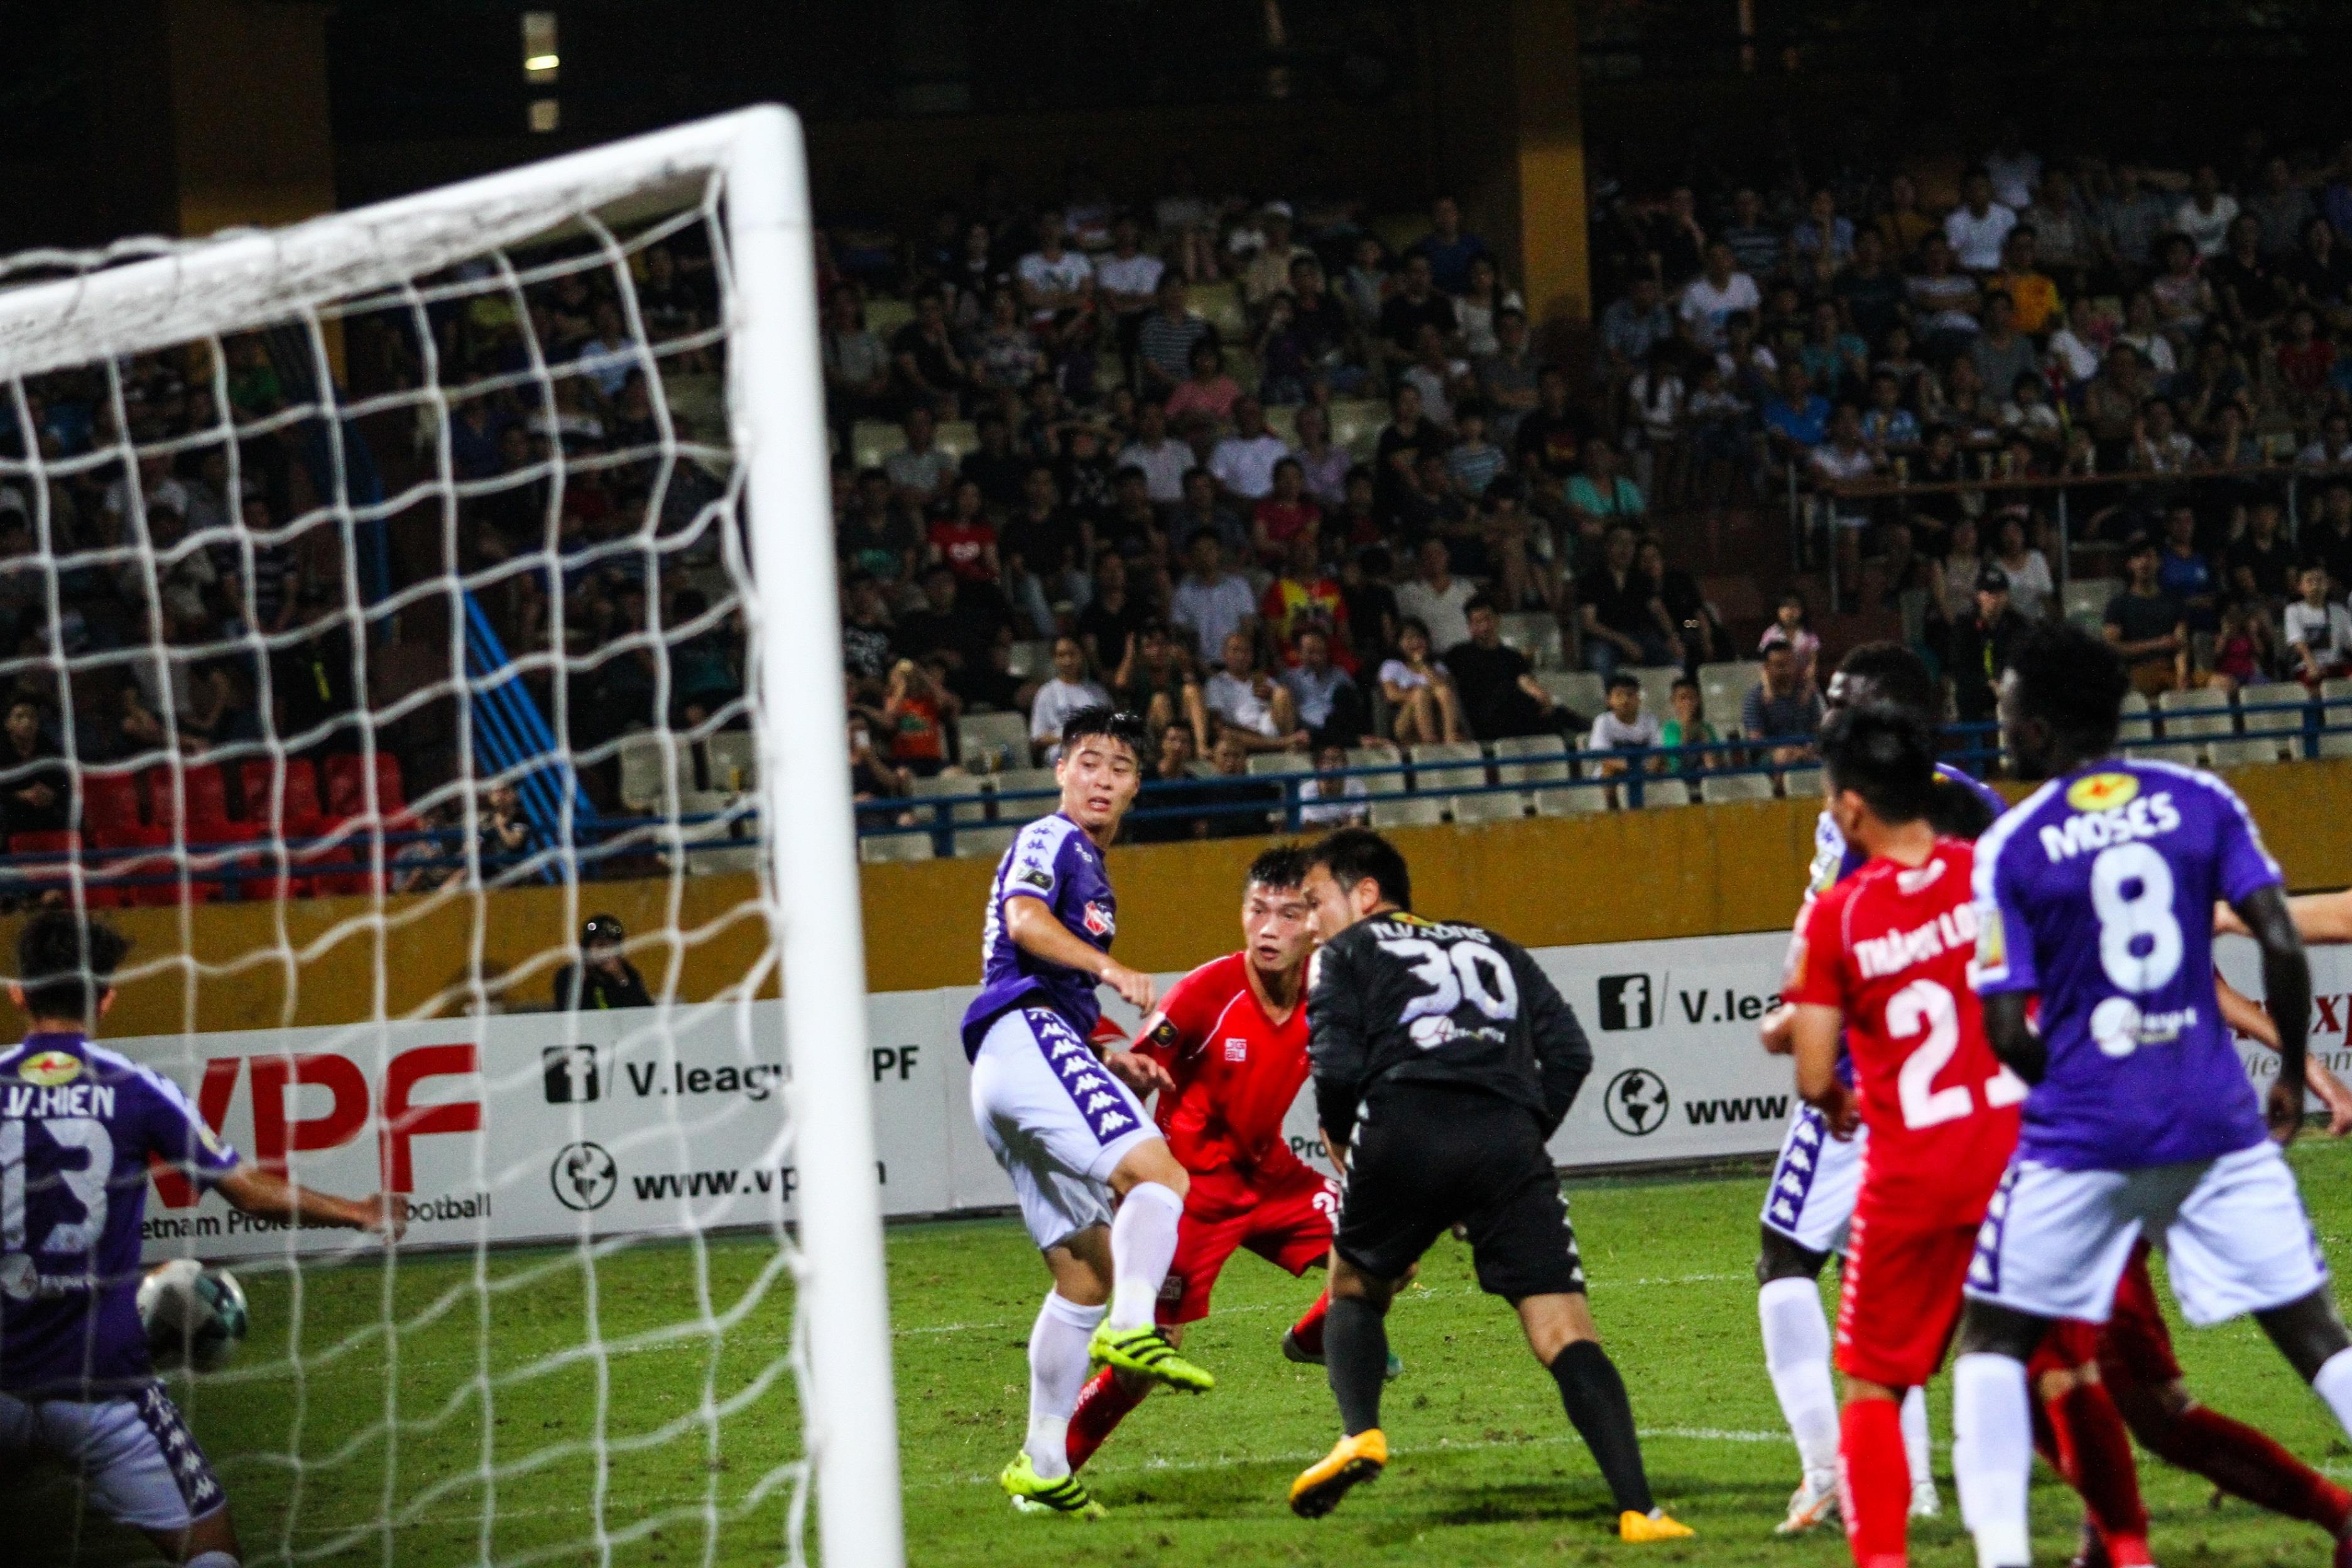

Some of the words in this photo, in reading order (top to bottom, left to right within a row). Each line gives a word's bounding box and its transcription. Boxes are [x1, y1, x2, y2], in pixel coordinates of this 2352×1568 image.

[2039, 792, 2181, 863] MOSES
[2091, 842, 2184, 994] 8
[1378, 939, 1519, 1024] 30
[1680, 989, 1783, 1024] V.lea
[867, 1045, 920, 1082] PF
[1685, 1095, 1788, 1126] www
[0, 1119, 115, 1253] 13
[141, 1217, 220, 1239] etnam
[406, 1192, 491, 1222] ootball
